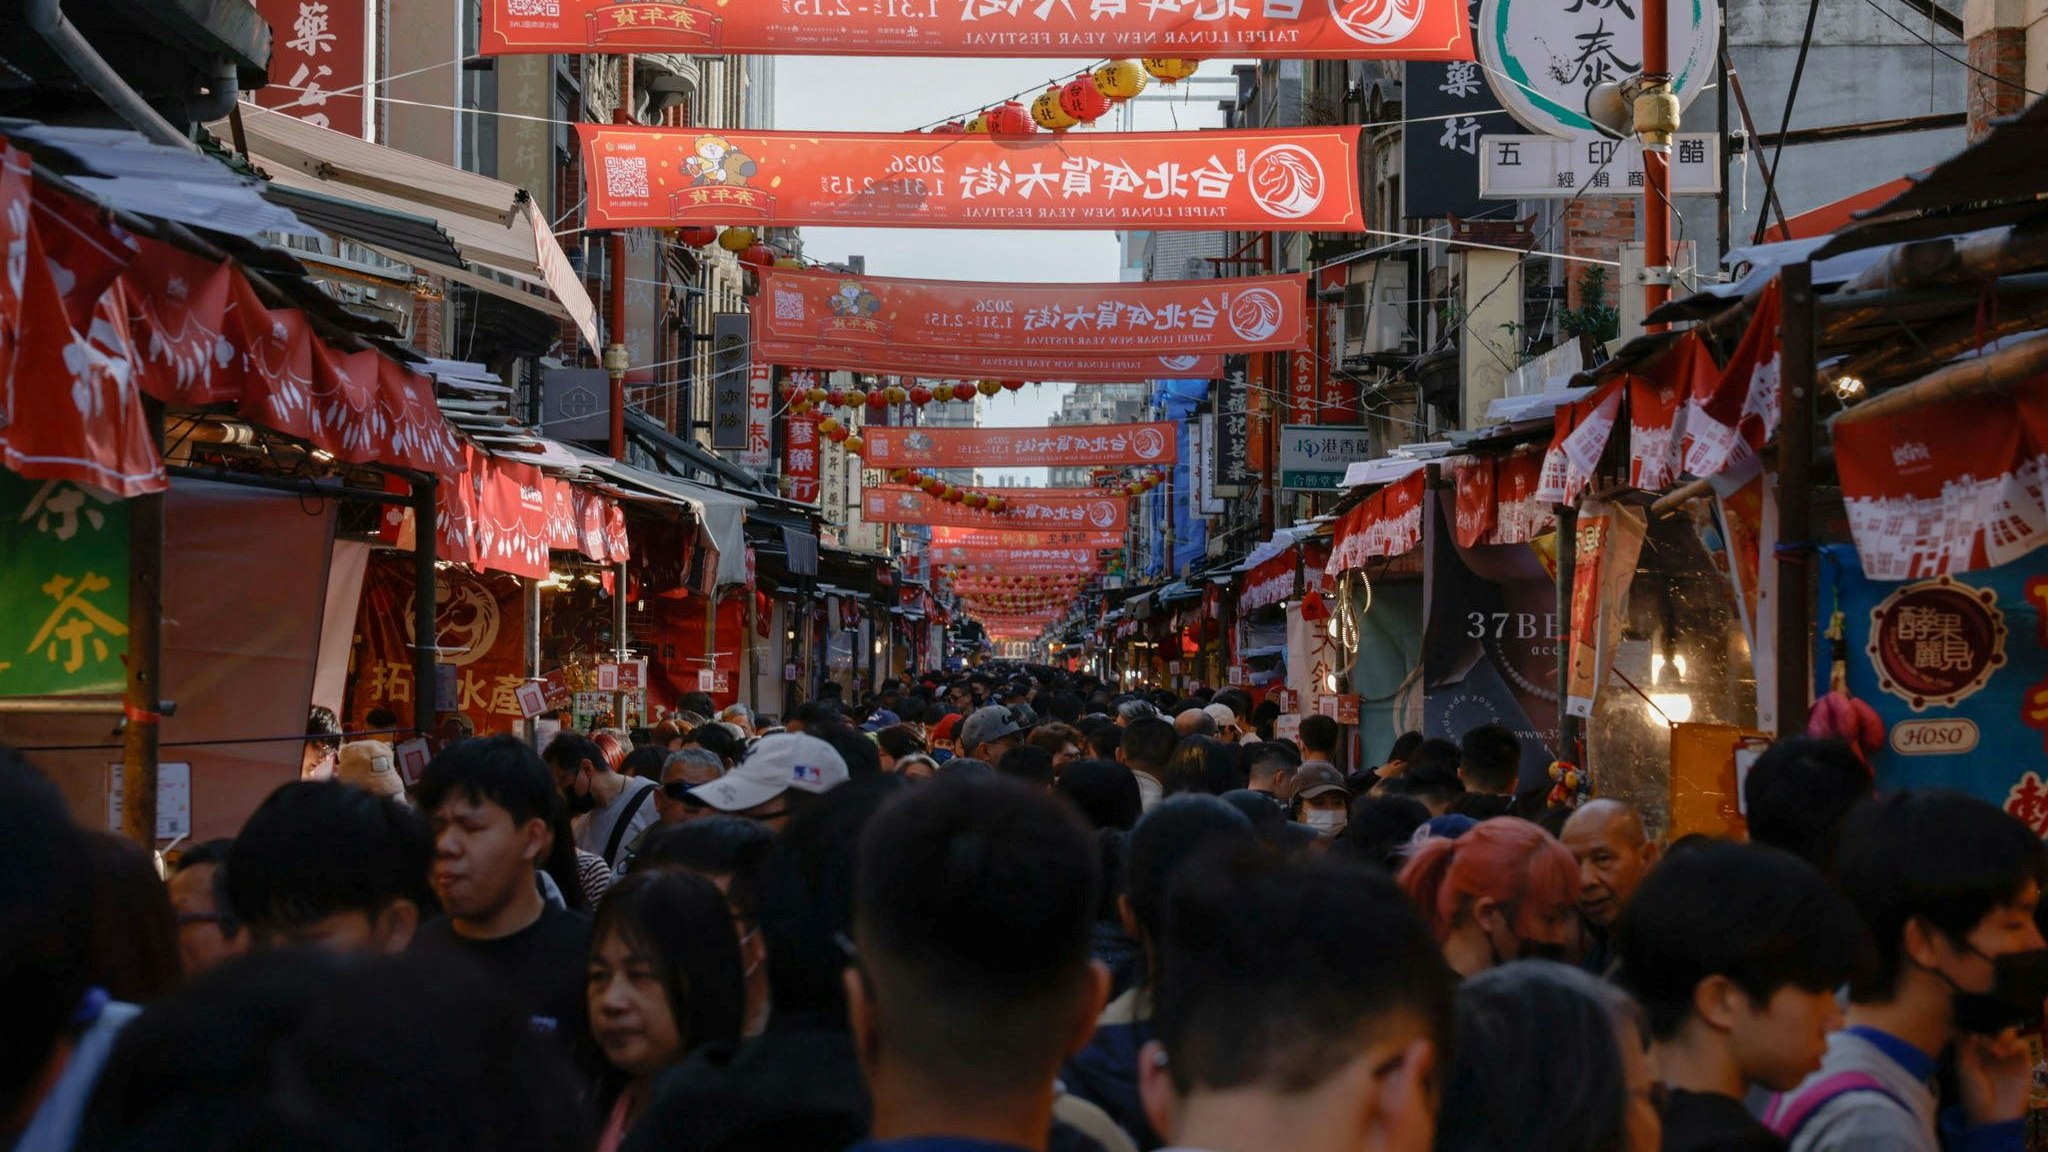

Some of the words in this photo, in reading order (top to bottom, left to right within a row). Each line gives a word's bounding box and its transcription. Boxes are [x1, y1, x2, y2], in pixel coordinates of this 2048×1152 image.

[1439, 61, 1481, 155] 藥行
[1498, 141, 1704, 165] 五印醋
[1557, 171, 1644, 188] 經銷商
[1321, 438, 1369, 455] 港香蘭
[27, 572, 130, 674] 茶
[371, 659, 525, 716] 拓水產
[1902, 726, 1963, 746] HOSO
